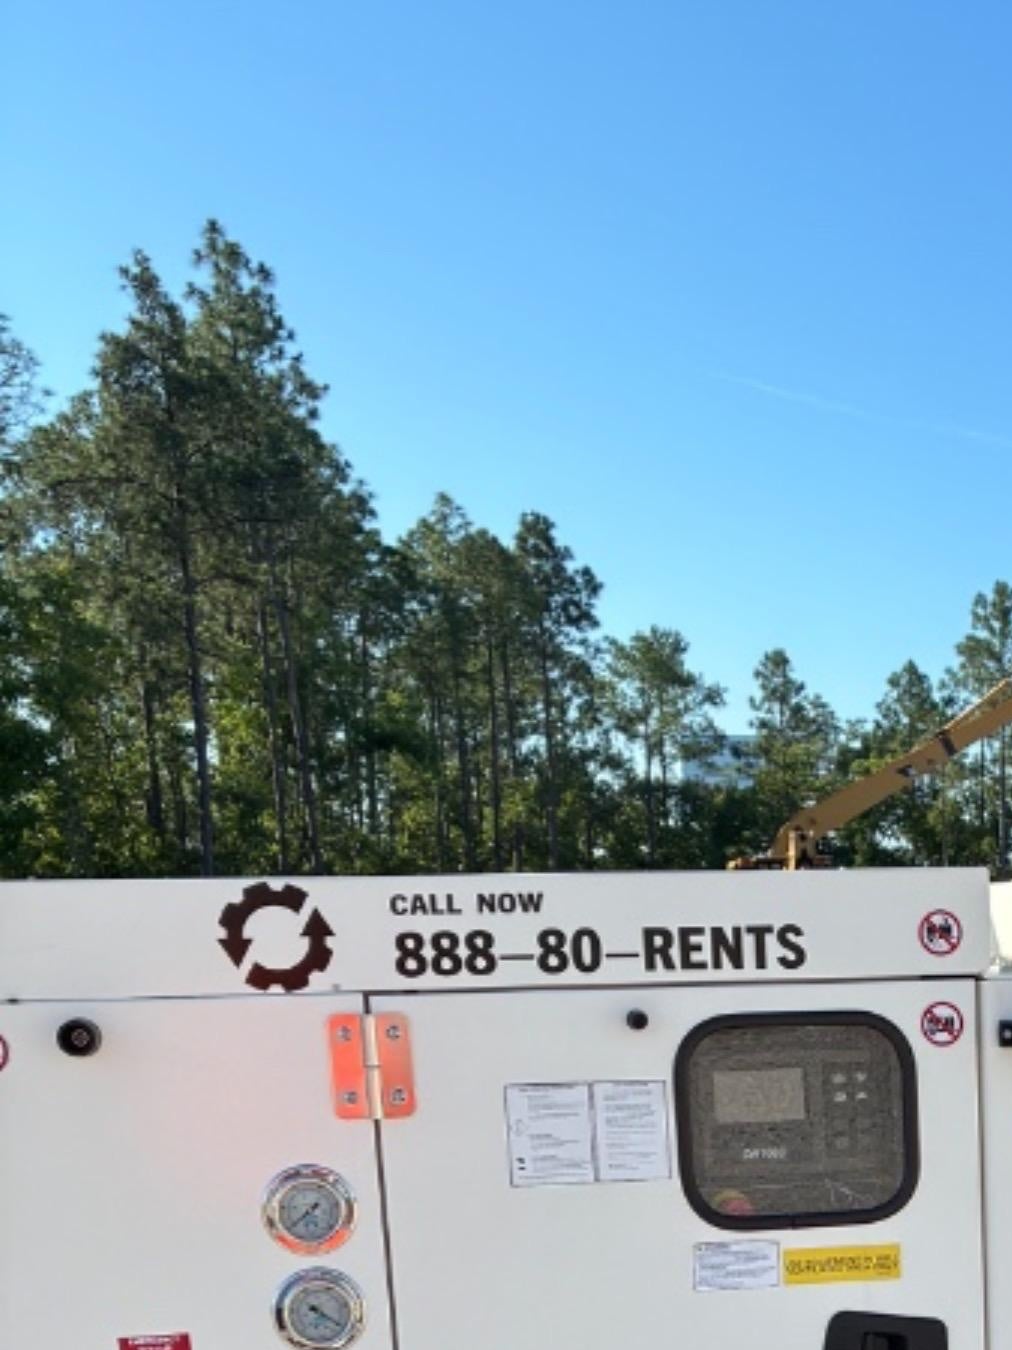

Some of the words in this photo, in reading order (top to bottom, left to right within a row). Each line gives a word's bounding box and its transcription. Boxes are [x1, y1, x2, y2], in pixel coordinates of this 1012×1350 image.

[389, 893, 463, 916] CALL
[476, 892, 544, 914] NOW
[394, 923, 808, 978] 888-80-RENTS
